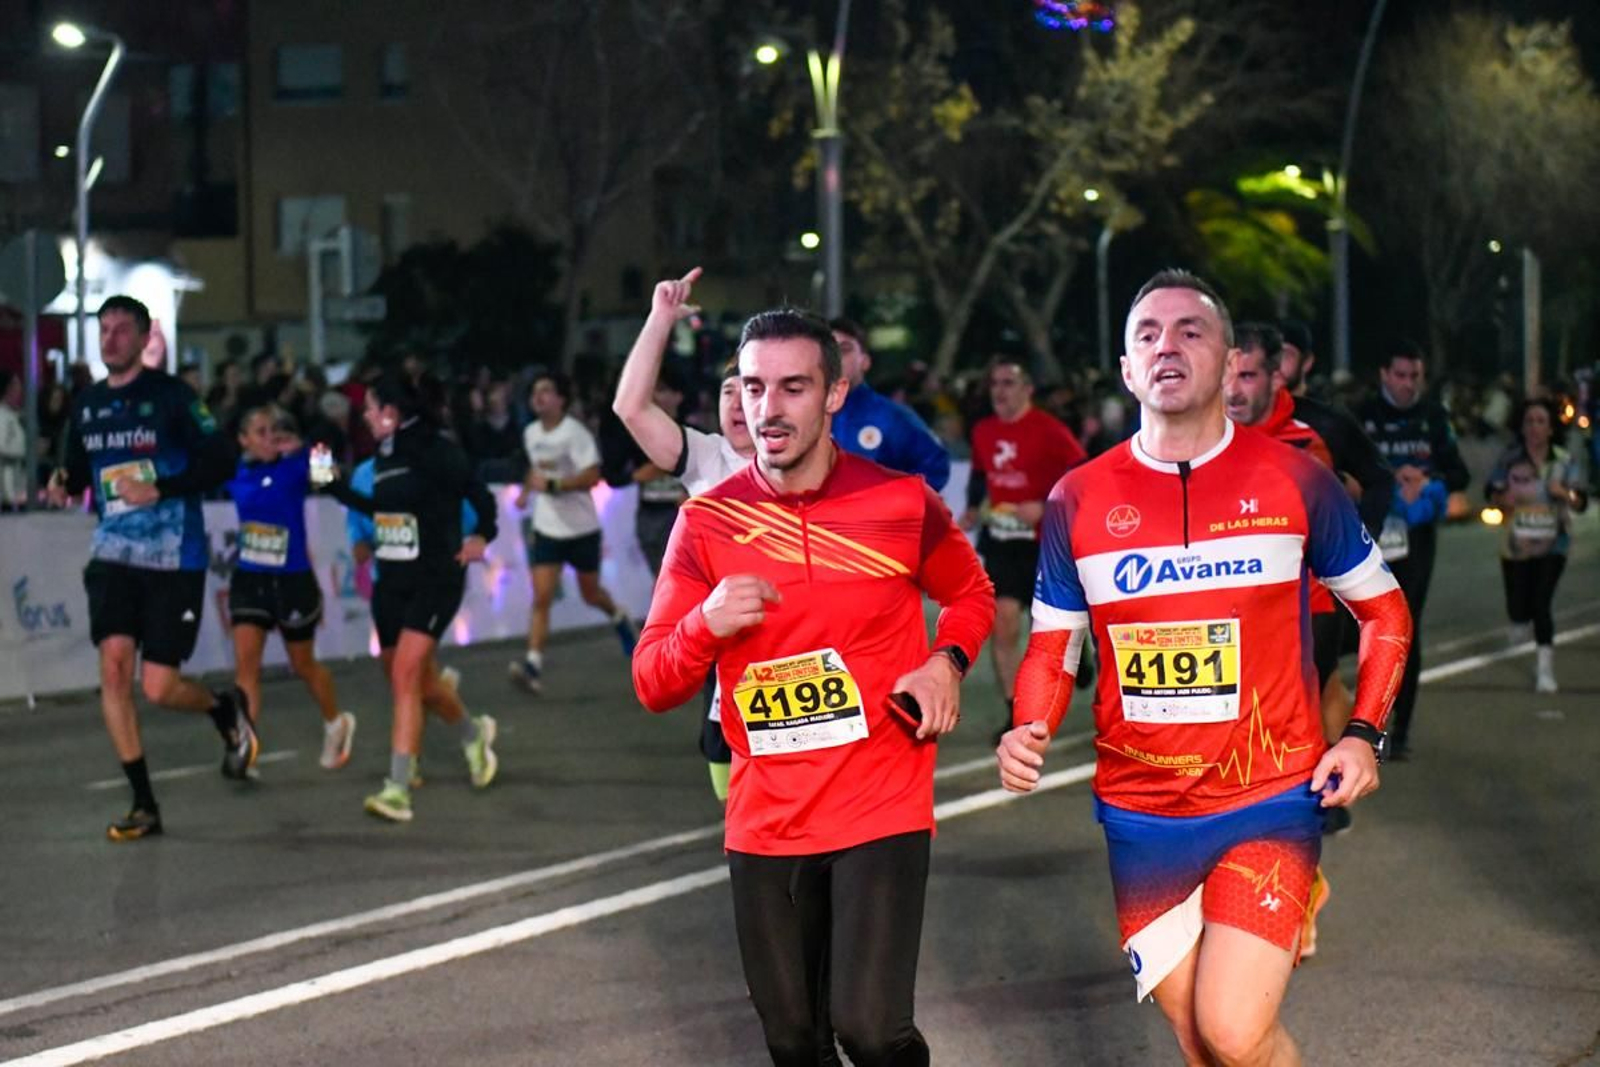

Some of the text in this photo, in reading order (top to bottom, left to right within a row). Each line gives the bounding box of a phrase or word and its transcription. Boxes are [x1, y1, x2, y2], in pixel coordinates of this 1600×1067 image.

[1209, 516, 1289, 533] DE LAS HERAS
[1177, 555, 1202, 564] GRUPO
[1155, 558, 1263, 583] Avanza
[1136, 629, 1156, 645] 42
[753, 667, 775, 683] 42
[1125, 650, 1223, 685] 4191
[749, 677, 848, 719] 4198
[1123, 744, 1203, 765] TRAILRUNNERS
